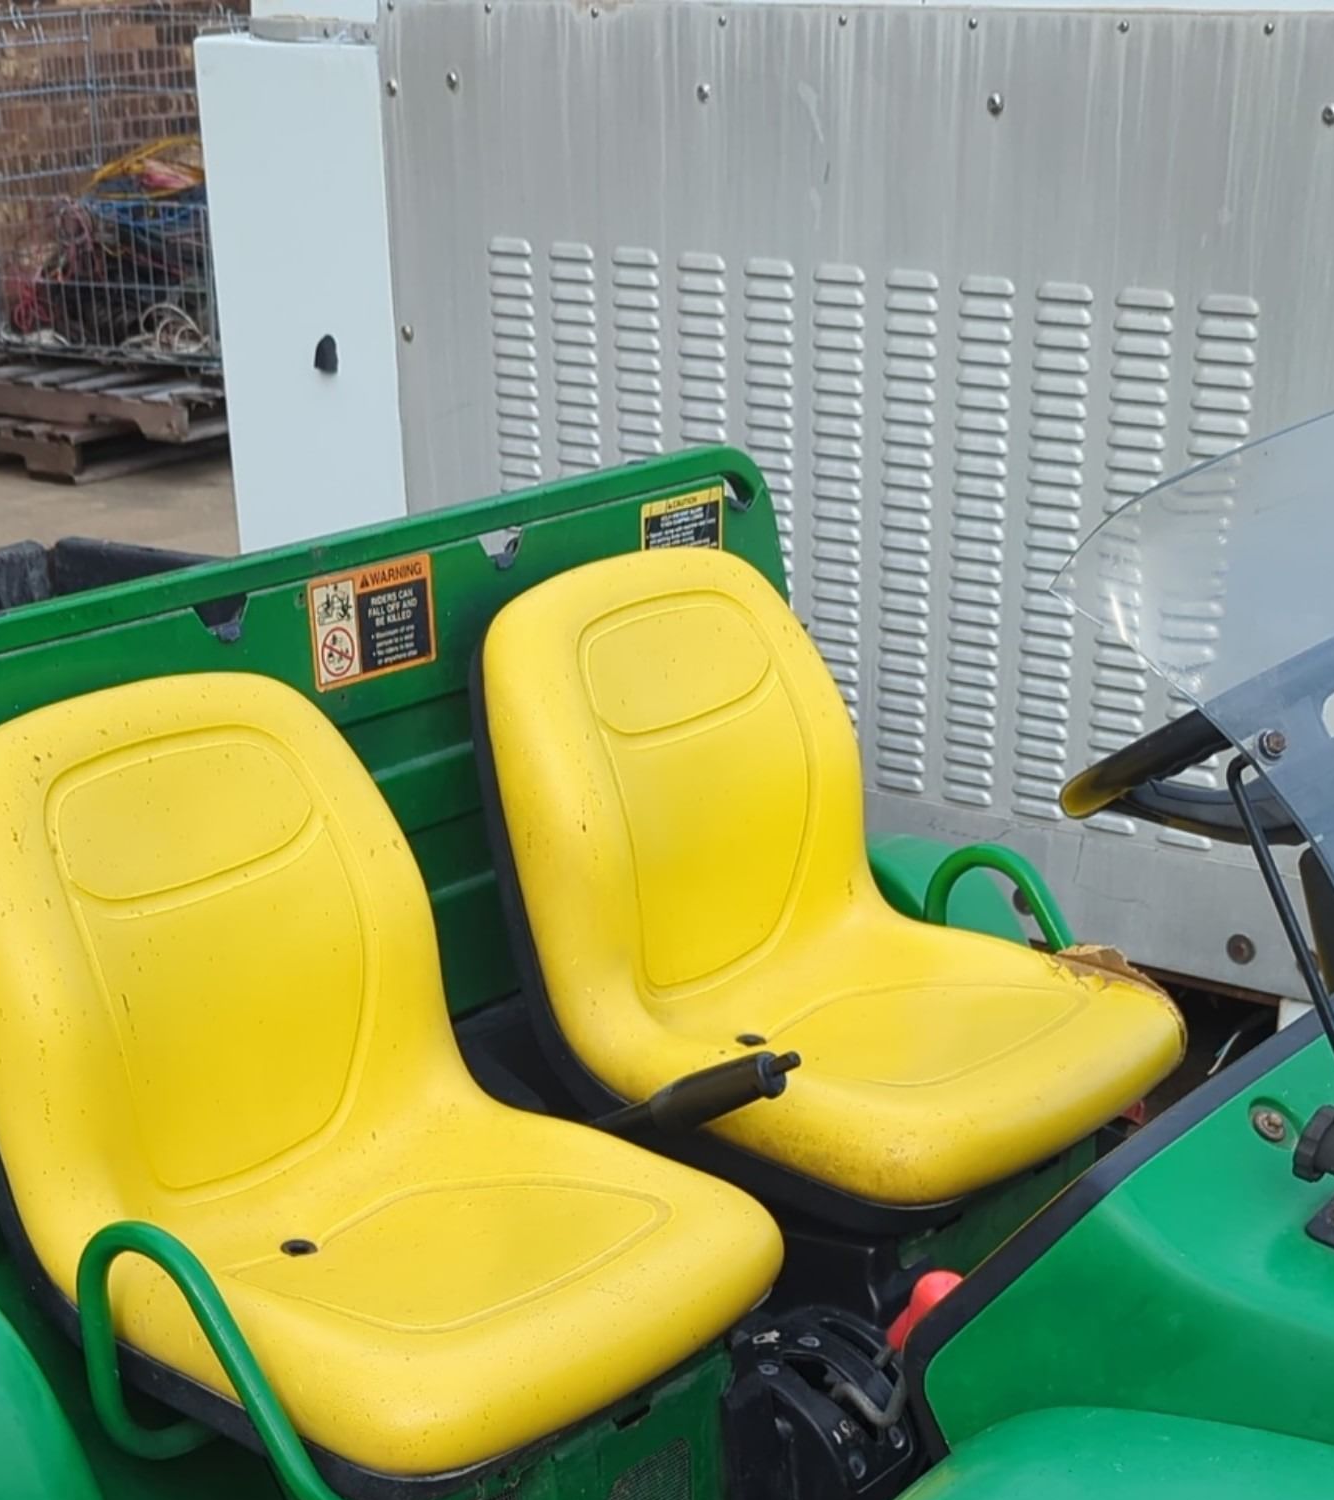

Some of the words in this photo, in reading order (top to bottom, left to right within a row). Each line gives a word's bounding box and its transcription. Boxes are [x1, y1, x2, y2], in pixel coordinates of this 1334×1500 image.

[369, 562, 423, 586] WARNING
[371, 591, 397, 606] RIDERS
[398, 587, 413, 600] CAN
[368, 606, 385, 618] FALL
[387, 601, 400, 613] OFF
[402, 597, 418, 609] AND
[375, 616, 385, 627] BE
[387, 609, 412, 623] KILLED
